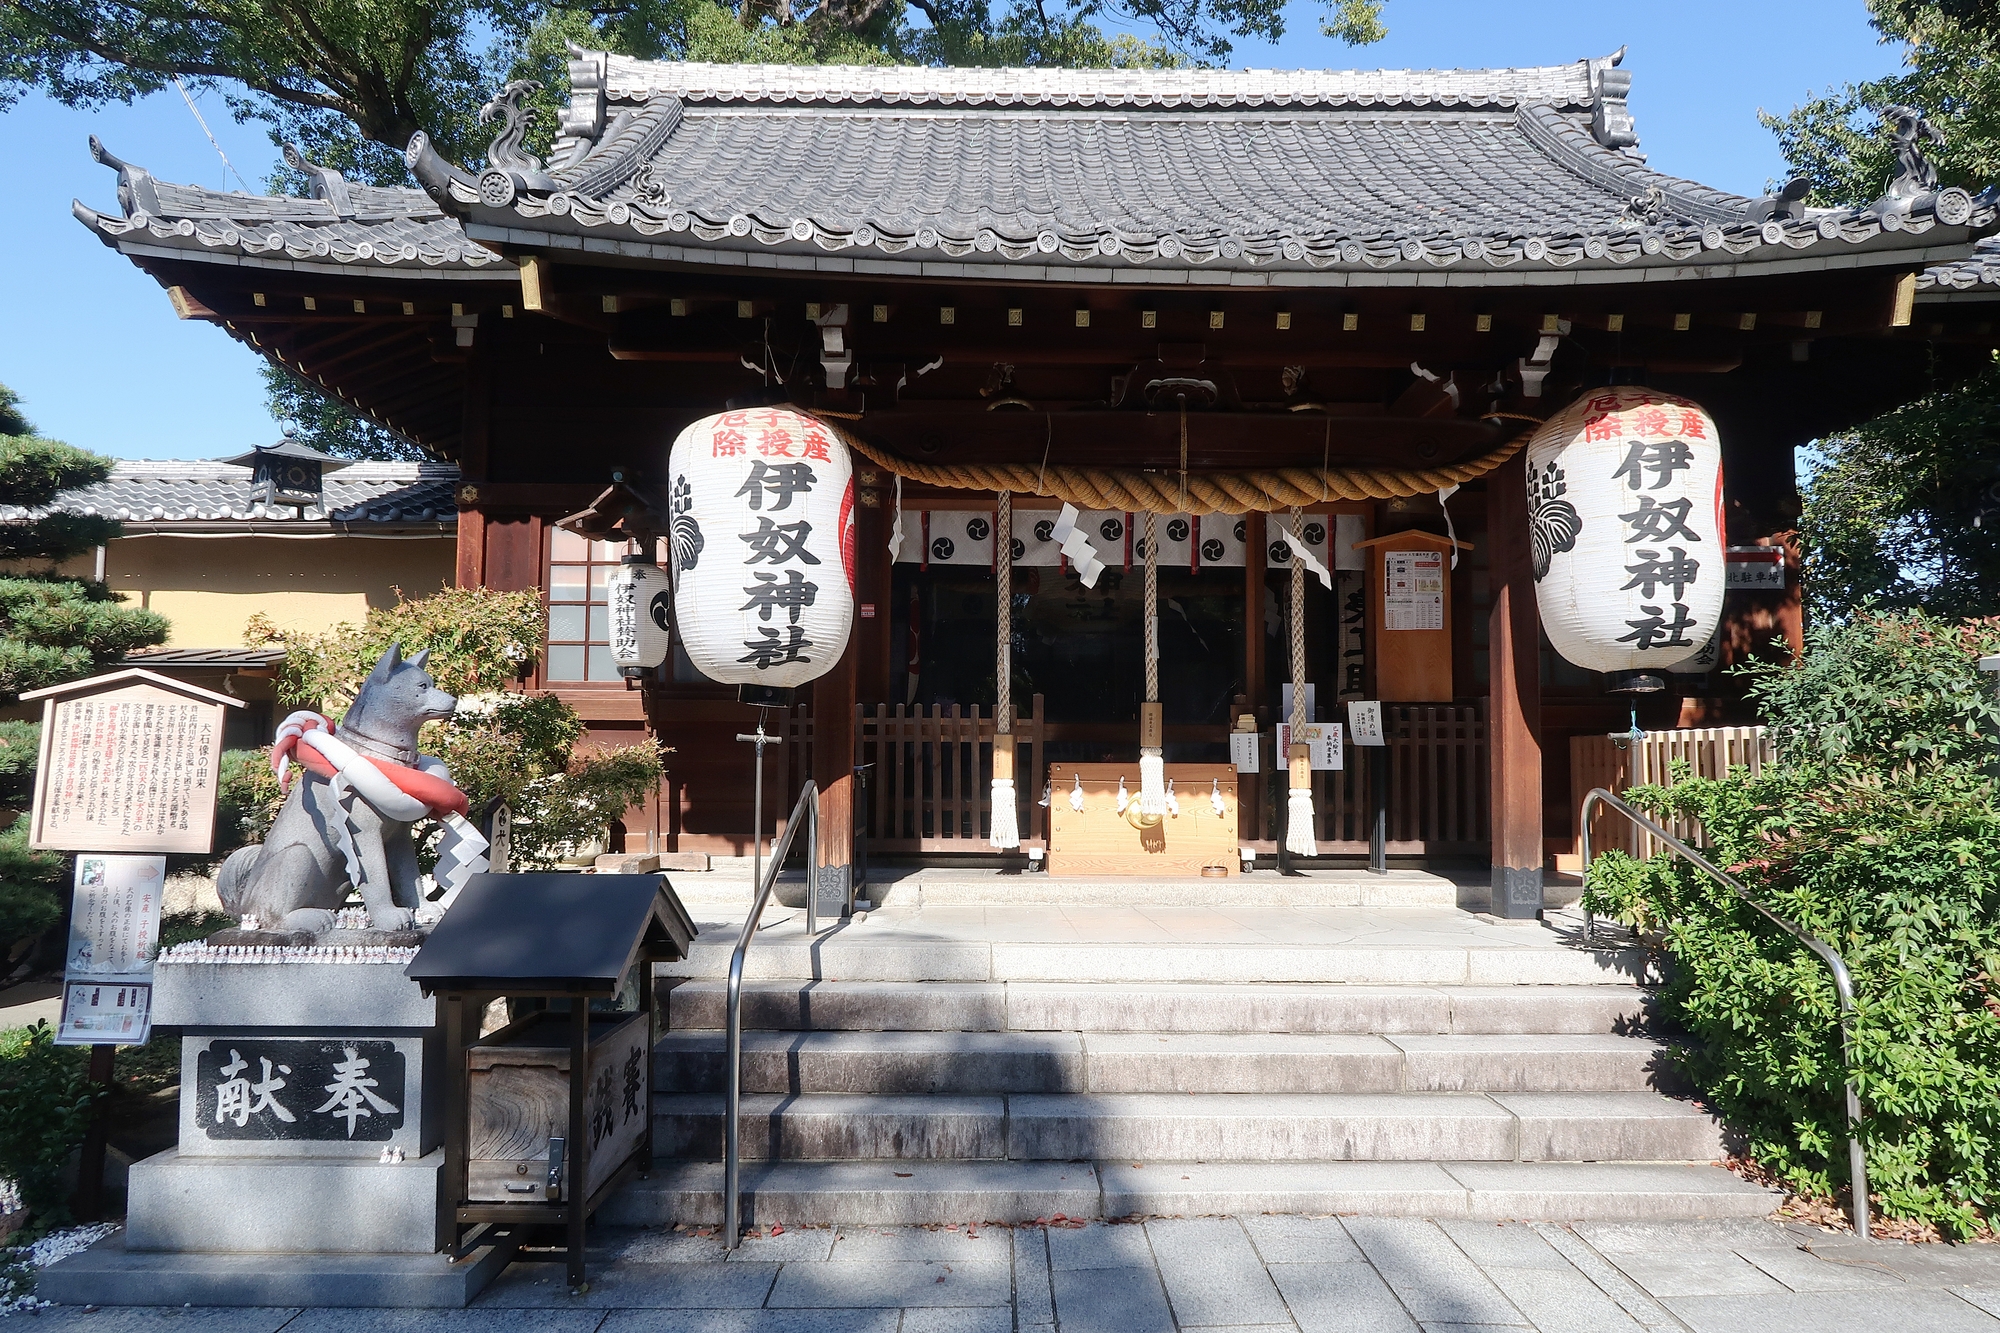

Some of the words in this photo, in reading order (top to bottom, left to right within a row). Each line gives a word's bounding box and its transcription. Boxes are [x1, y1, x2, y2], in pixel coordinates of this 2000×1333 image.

[711, 411, 750, 458] 厄除
[1582, 393, 1623, 443] 厄除
[734, 459, 821, 670] 伊奴神社
[1611, 440, 1702, 651] 伊奴神社
[1727, 571, 1780, 584] 北駐車場
[195, 723, 212, 788] 犬石像の由来
[136, 893, 152, 959] 安産・子授祈願
